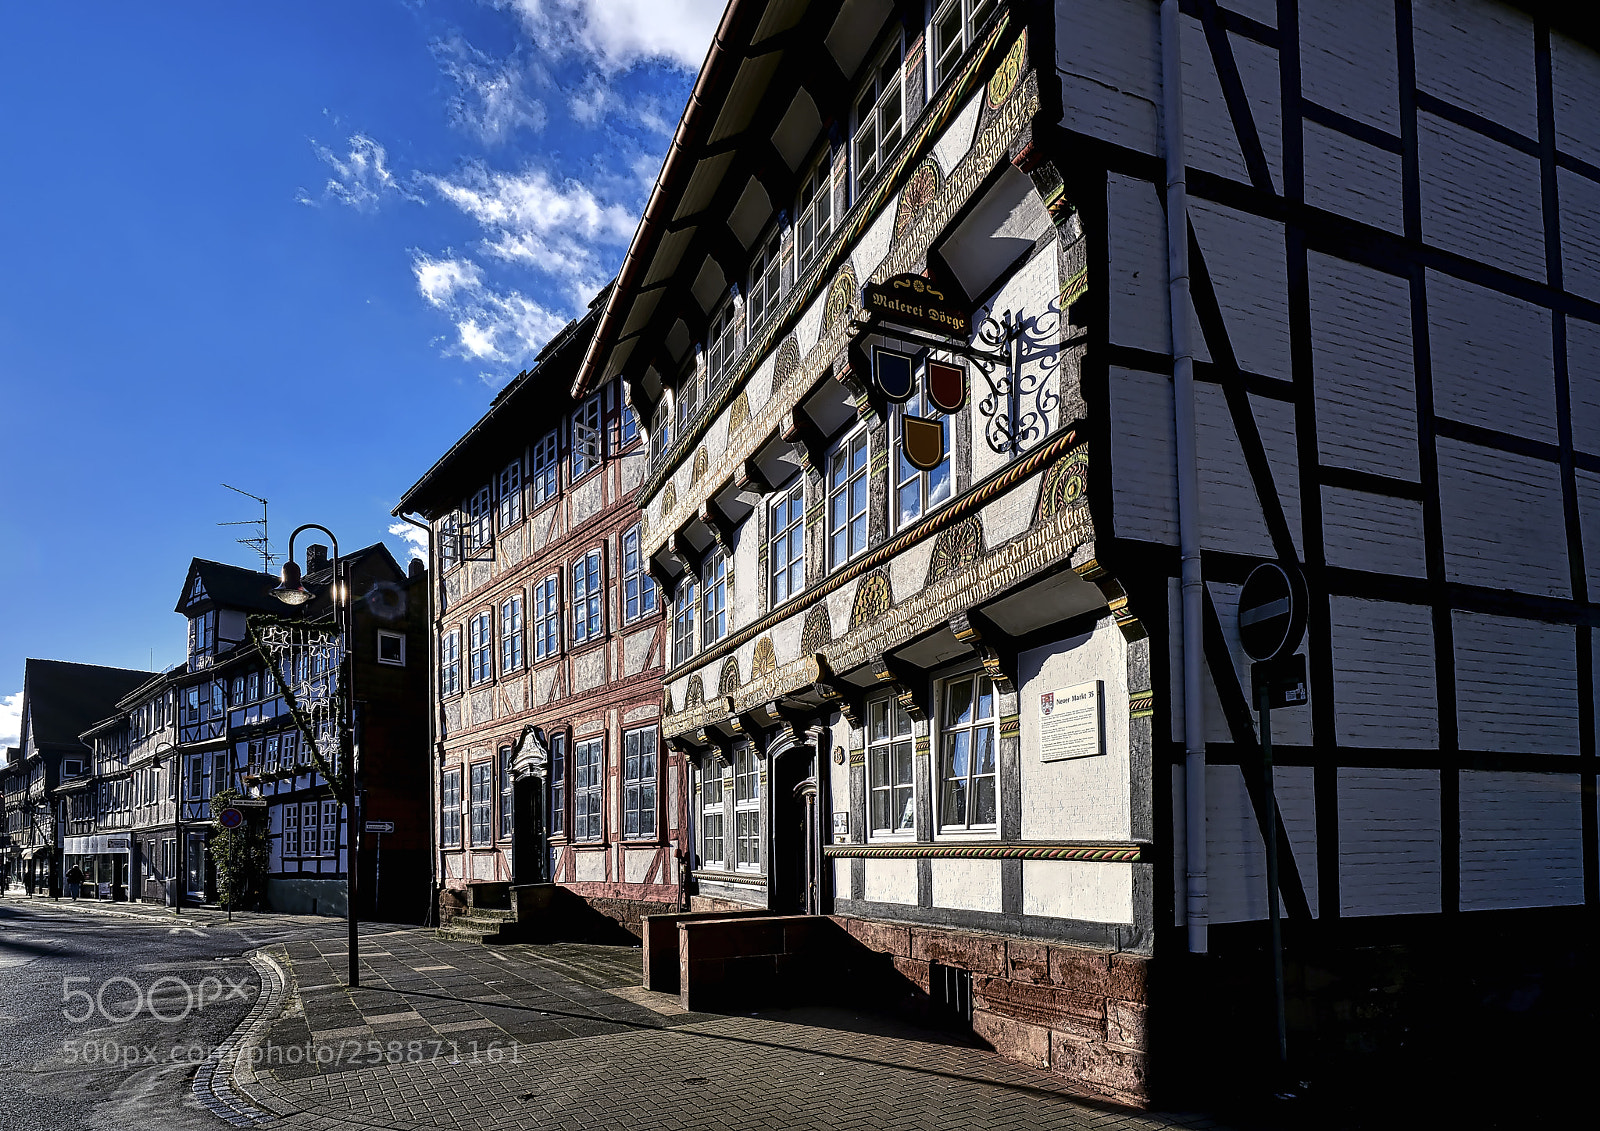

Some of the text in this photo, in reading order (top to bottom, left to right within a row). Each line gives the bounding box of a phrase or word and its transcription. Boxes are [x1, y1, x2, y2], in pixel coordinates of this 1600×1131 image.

[872, 292, 965, 330] Malerei Dörge
[1056, 697, 1070, 706] Neuer
[1071, 692, 1087, 702] Markt
